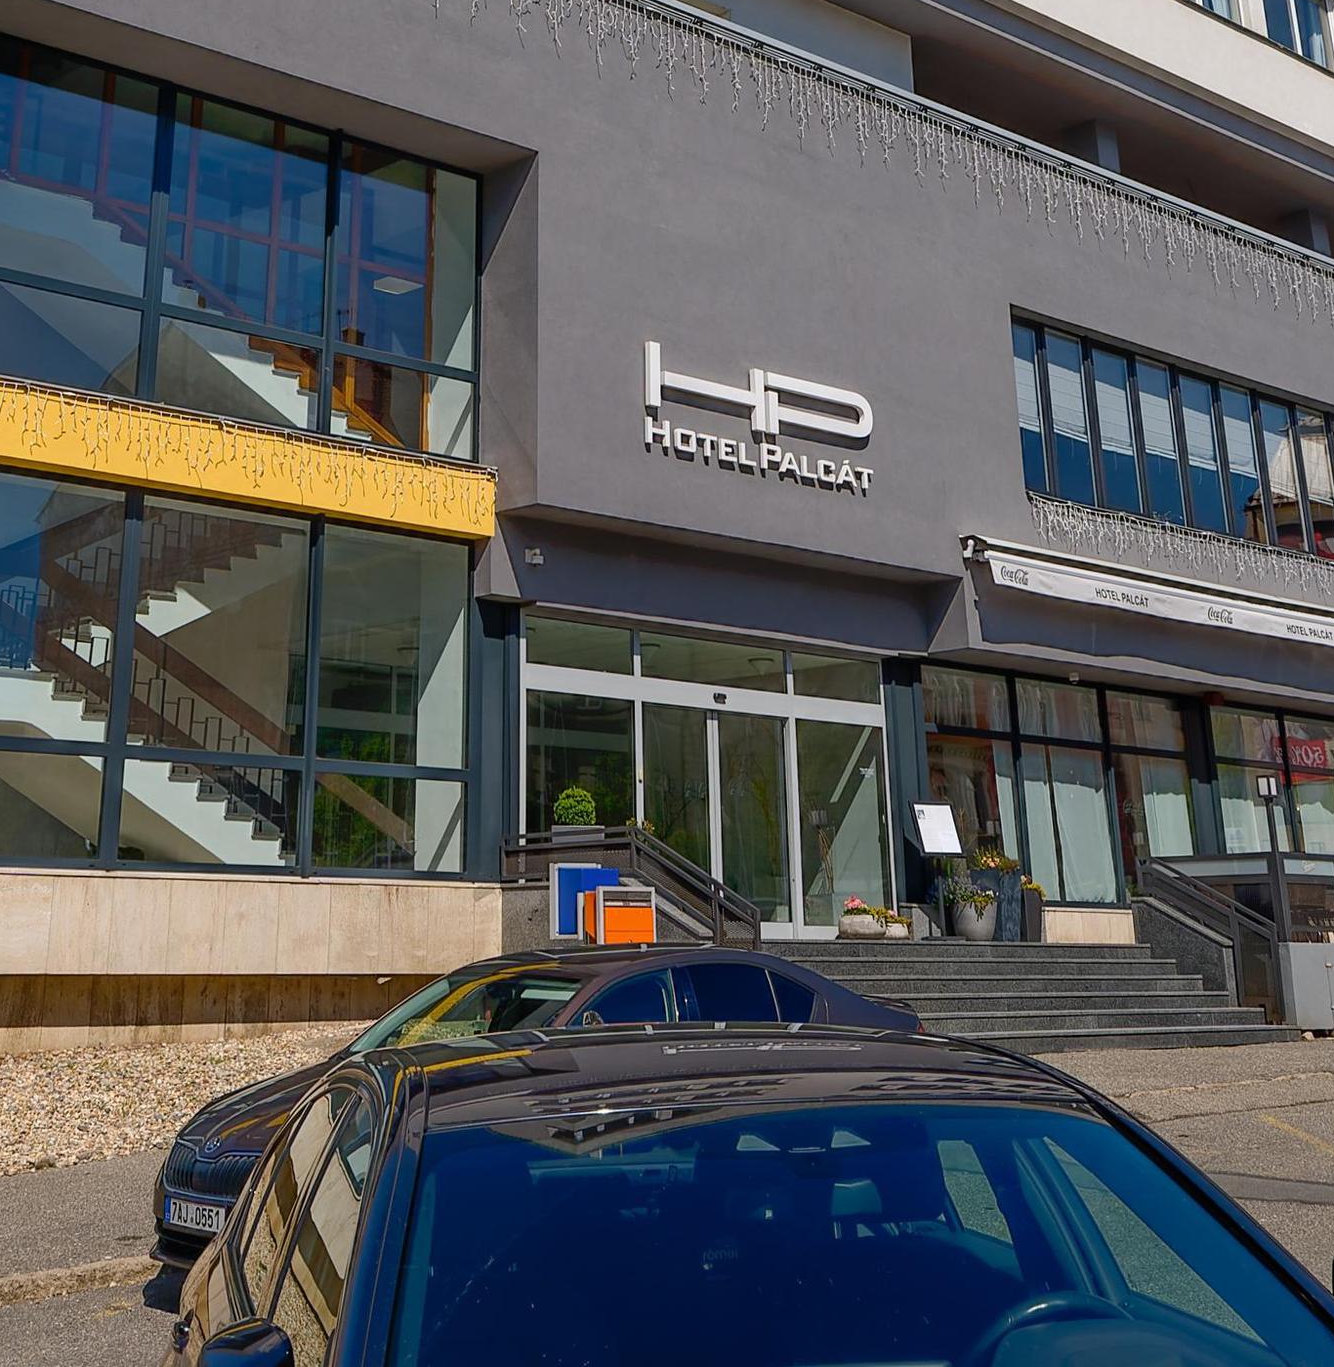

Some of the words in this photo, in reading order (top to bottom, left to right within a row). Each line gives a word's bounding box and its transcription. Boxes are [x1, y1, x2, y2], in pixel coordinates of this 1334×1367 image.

[644, 416, 757, 467] HOTEL
[760, 442, 875, 490] PALCÁT
[1095, 587, 1121, 602] HOTEL
[1121, 592, 1149, 608] PALCÁT
[1286, 624, 1309, 637] HOTEL
[171, 1201, 189, 1224] 7AJ
[194, 1206, 220, 1230] 0551
